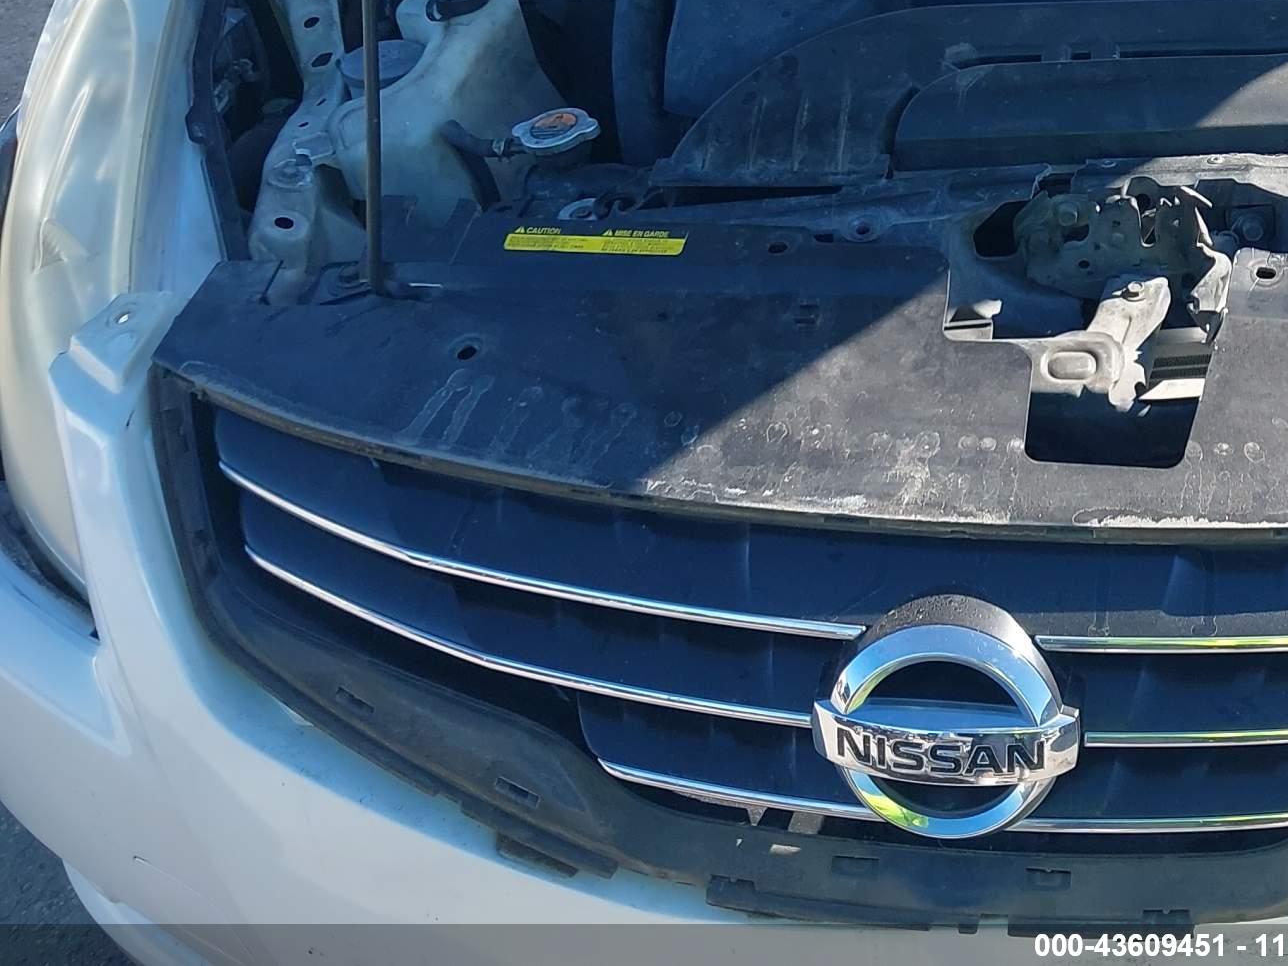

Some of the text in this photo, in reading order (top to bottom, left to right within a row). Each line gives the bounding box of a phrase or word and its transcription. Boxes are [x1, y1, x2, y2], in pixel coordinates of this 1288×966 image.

[526, 226, 562, 235] CAUTION
[614, 229, 670, 238] MISE EN GARDE
[835, 726, 1046, 776] NISSAN
